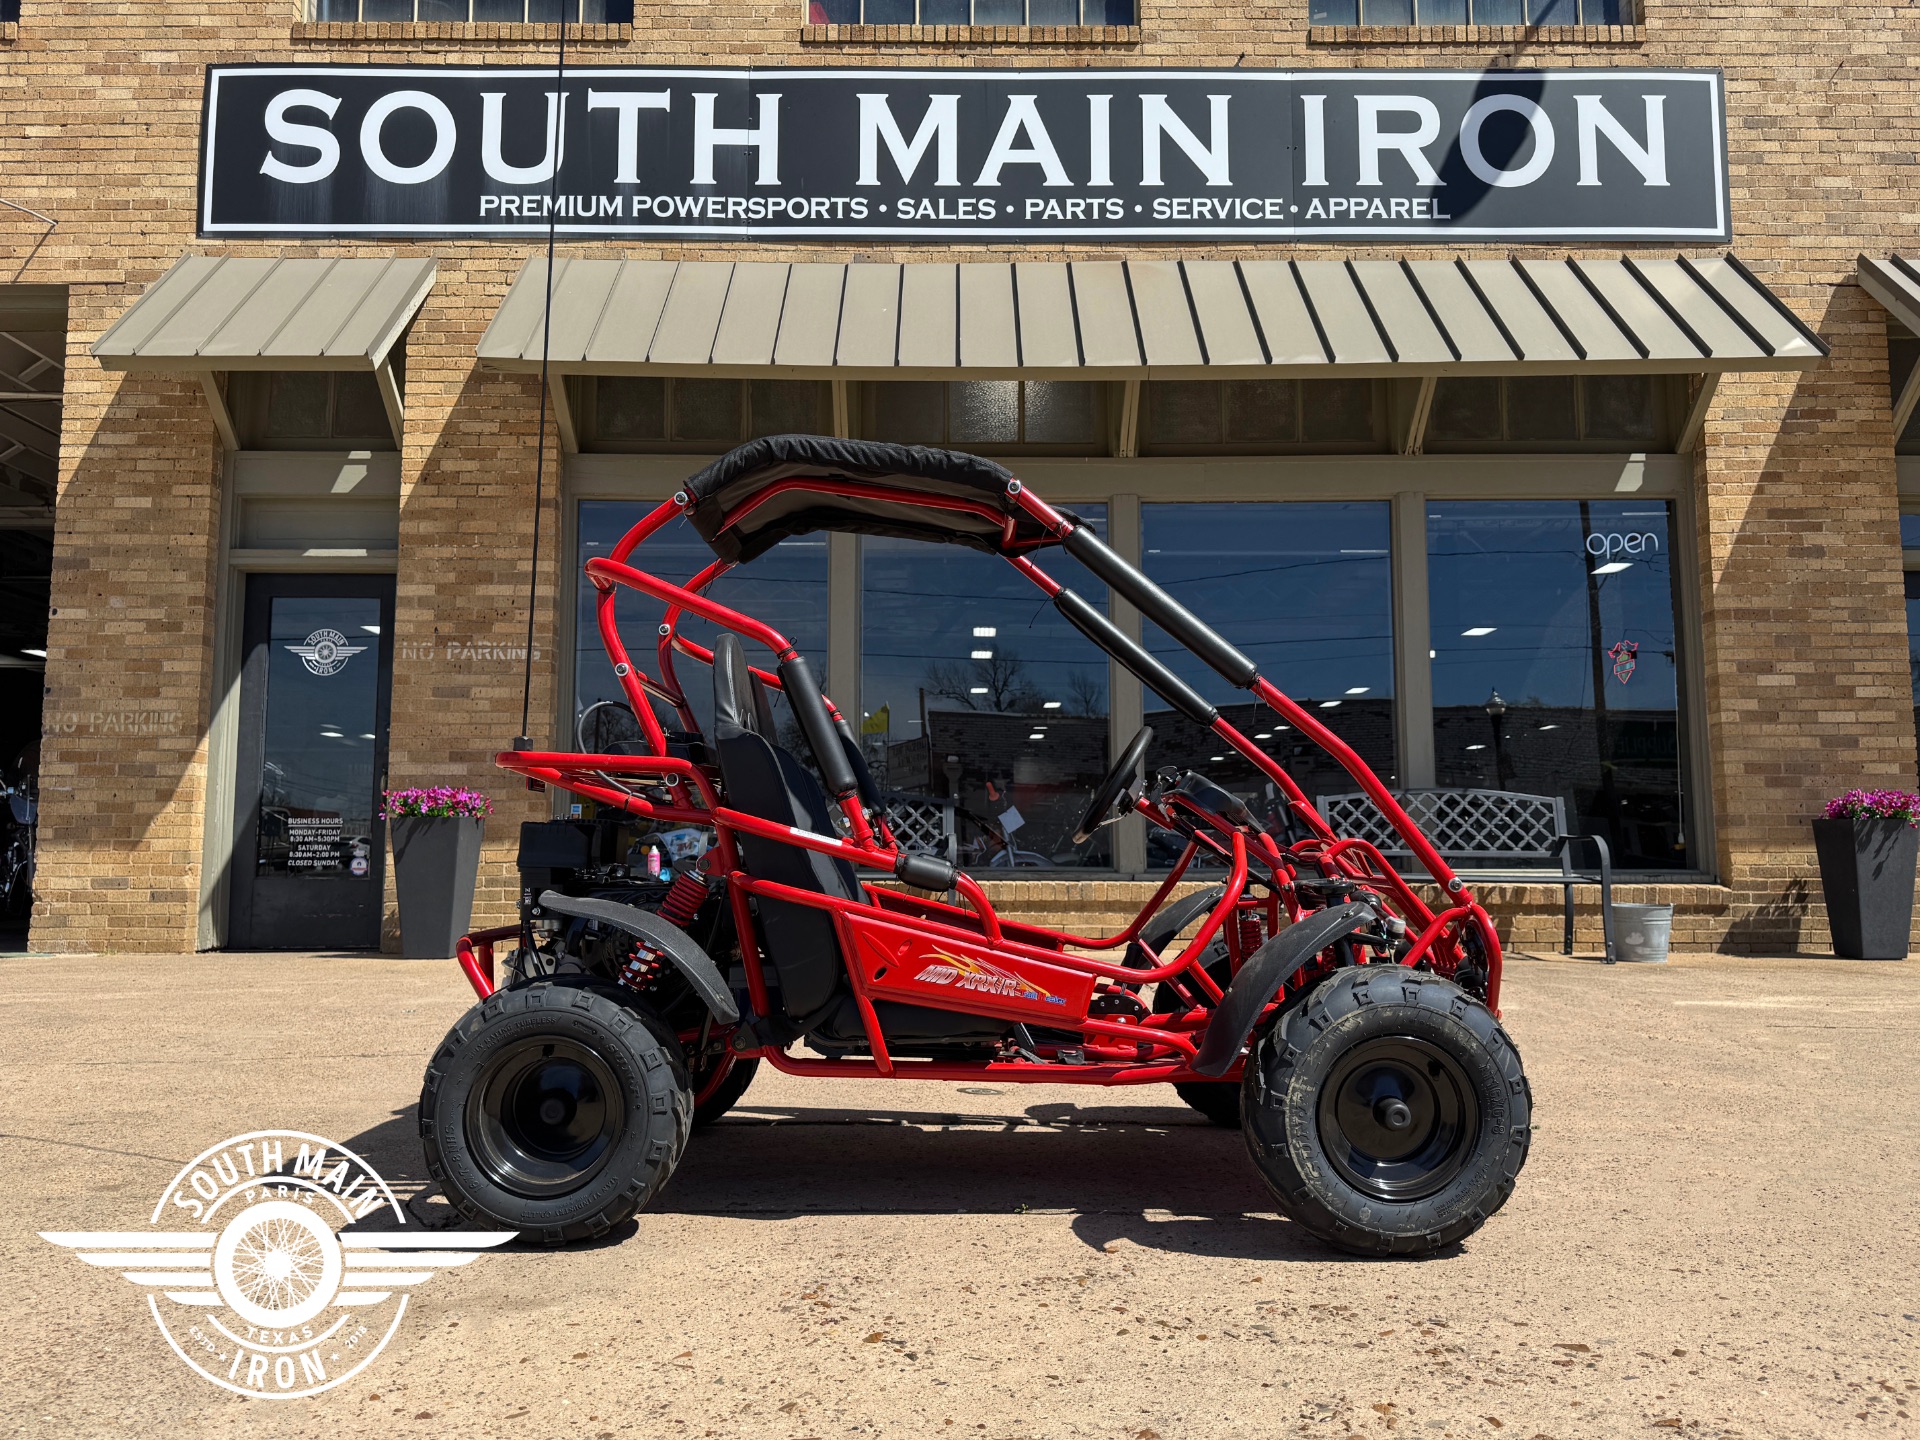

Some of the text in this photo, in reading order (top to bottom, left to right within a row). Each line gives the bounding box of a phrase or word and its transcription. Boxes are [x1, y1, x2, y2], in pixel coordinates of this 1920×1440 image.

[260, 88, 1671, 188] SOUTH MAIN IRON
[480, 195, 1452, 221] PREMIUM POWERSPORTS SALES PARTS SERVICE APPAREL
[1586, 532, 1659, 560] open
[307, 631, 345, 646] SOUTH MAIN
[402, 641, 541, 661] NO PARKING
[45, 712, 183, 733] NO PARKING
[287, 817, 320, 825] BUSINESS
